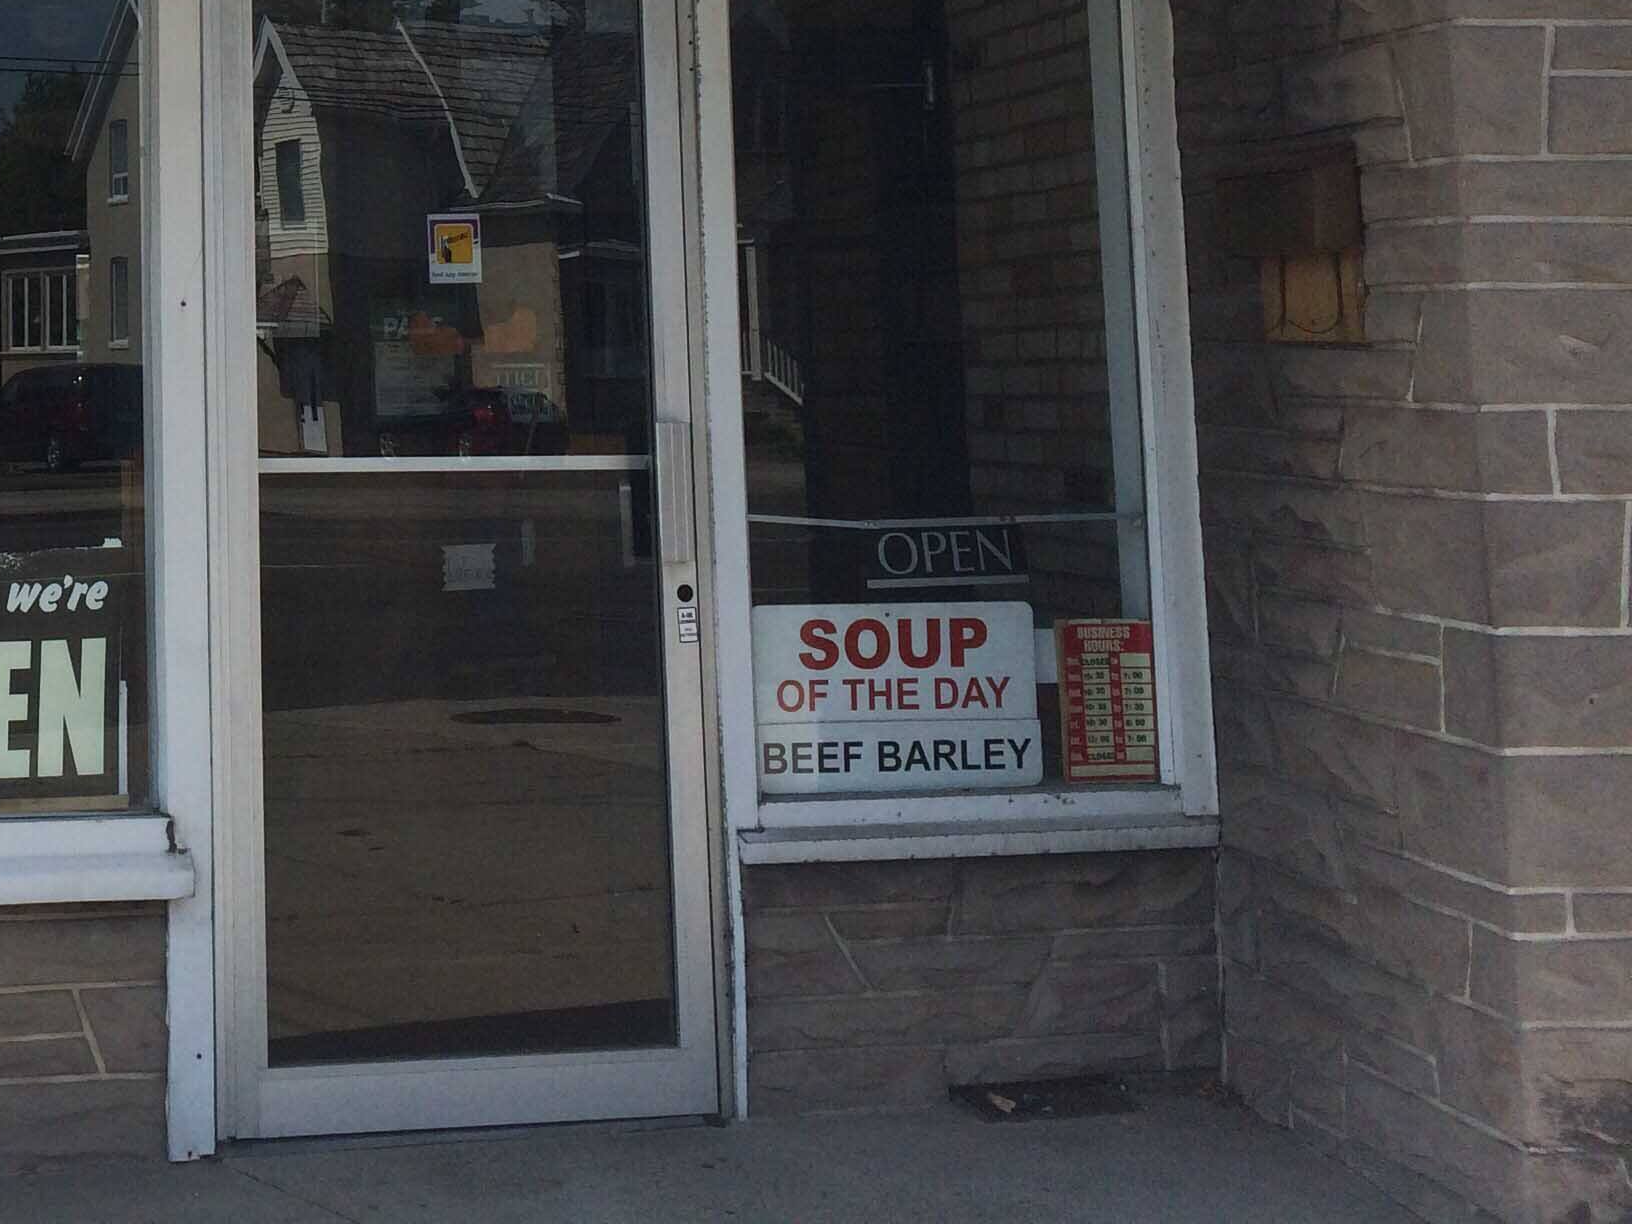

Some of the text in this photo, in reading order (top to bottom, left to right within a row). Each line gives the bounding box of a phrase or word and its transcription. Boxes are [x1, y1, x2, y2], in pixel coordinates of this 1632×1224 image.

[876, 529, 1014, 575] OPEN
[6, 575, 109, 614] we're
[798, 617, 988, 671] SOUP
[776, 676, 1010, 712] OF THE DAY
[763, 738, 1032, 775] BEEF BARLEY
